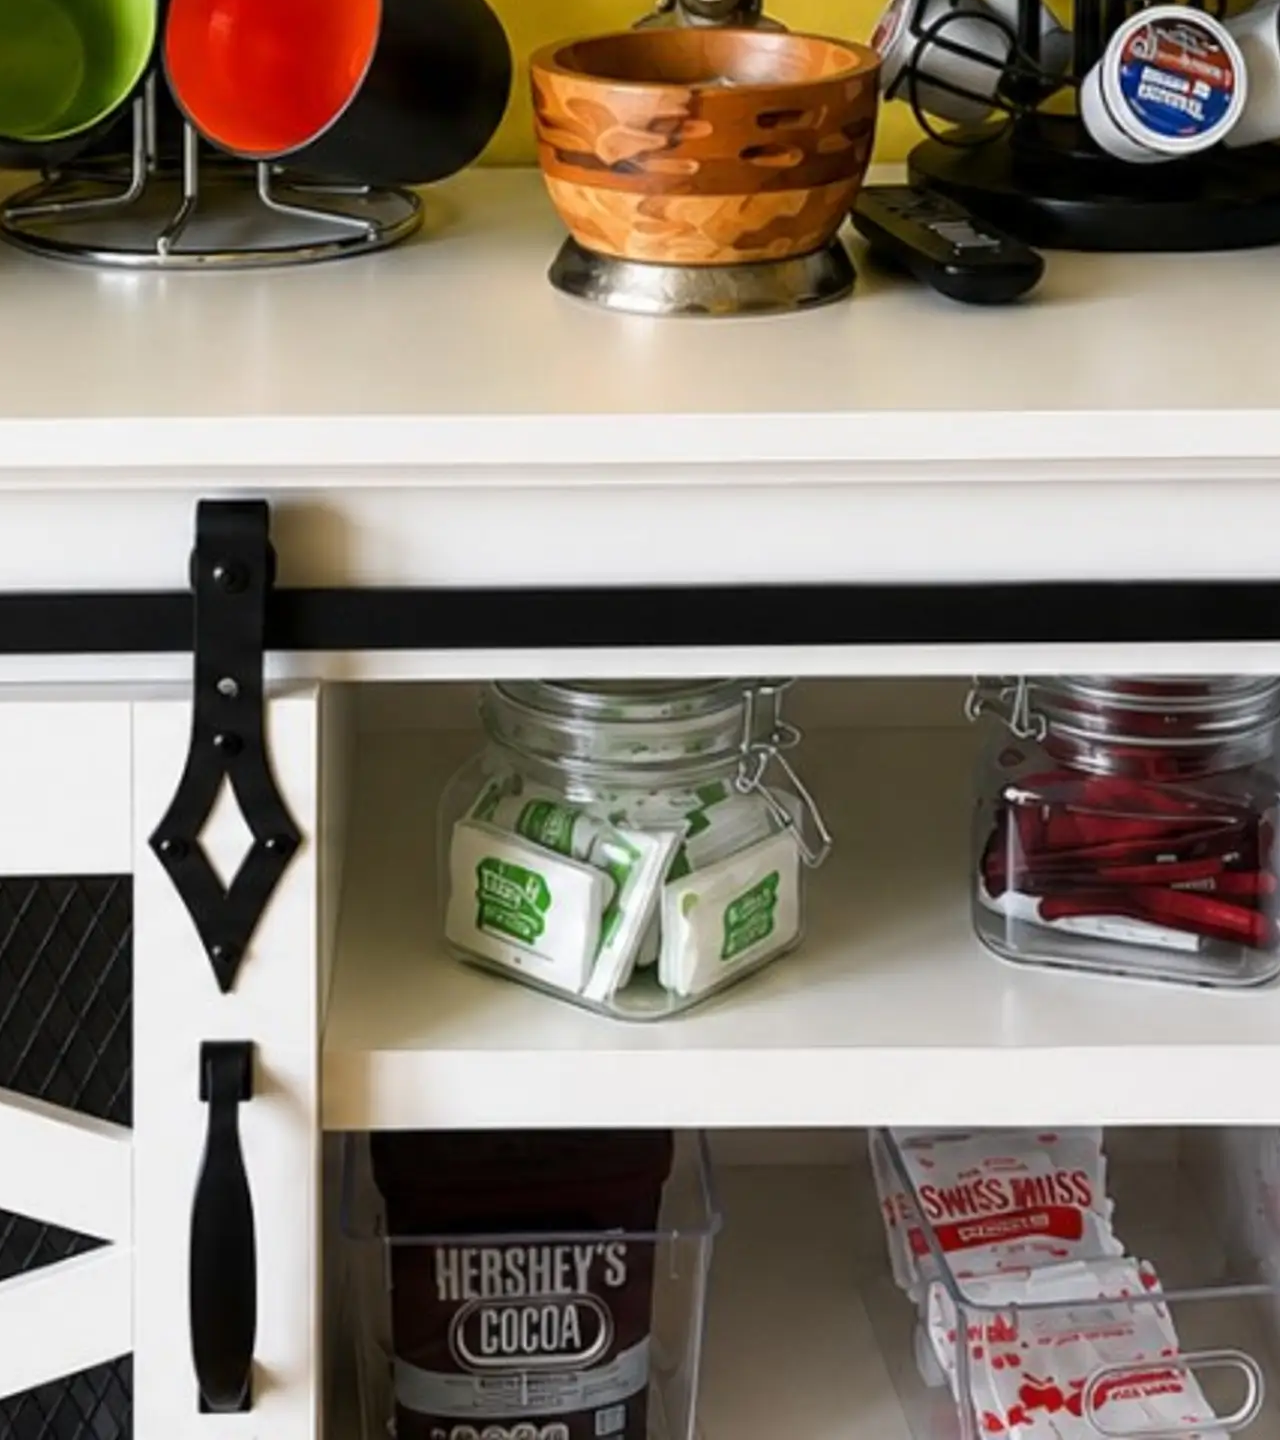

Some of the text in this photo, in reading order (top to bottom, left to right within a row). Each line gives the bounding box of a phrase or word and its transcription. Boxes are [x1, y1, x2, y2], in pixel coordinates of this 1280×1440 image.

[920, 1176, 1010, 1220] SWISS
[1009, 1169, 1092, 1209] MISS
[434, 1240, 627, 1301] HERSHEY'S
[479, 1303, 582, 1355] COCOA
